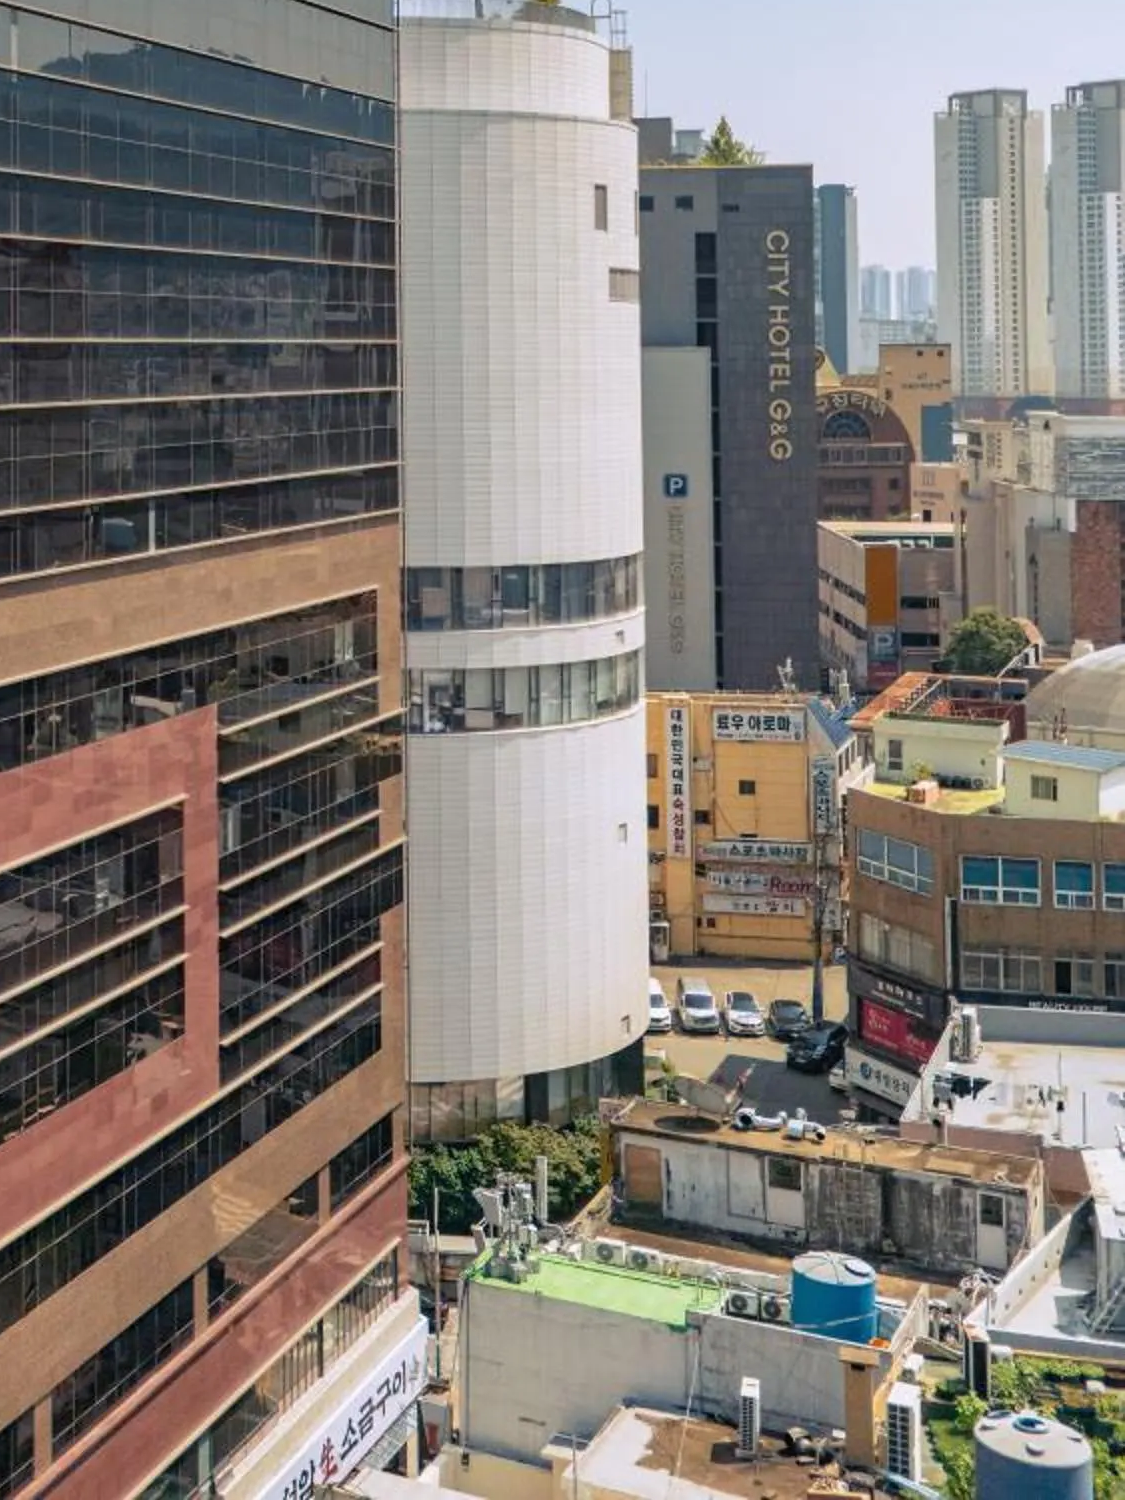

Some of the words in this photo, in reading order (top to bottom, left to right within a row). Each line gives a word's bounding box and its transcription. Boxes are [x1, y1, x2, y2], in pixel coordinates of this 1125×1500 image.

[766, 229, 790, 296] CITY
[768, 305, 791, 392] HOTEL
[769, 399, 793, 460] G&G
[670, 477, 684, 495] P
[876, 634, 893, 650] P
[748, 713, 792, 733] 아로마
[340, 1359, 406, 1460] 소금구이
